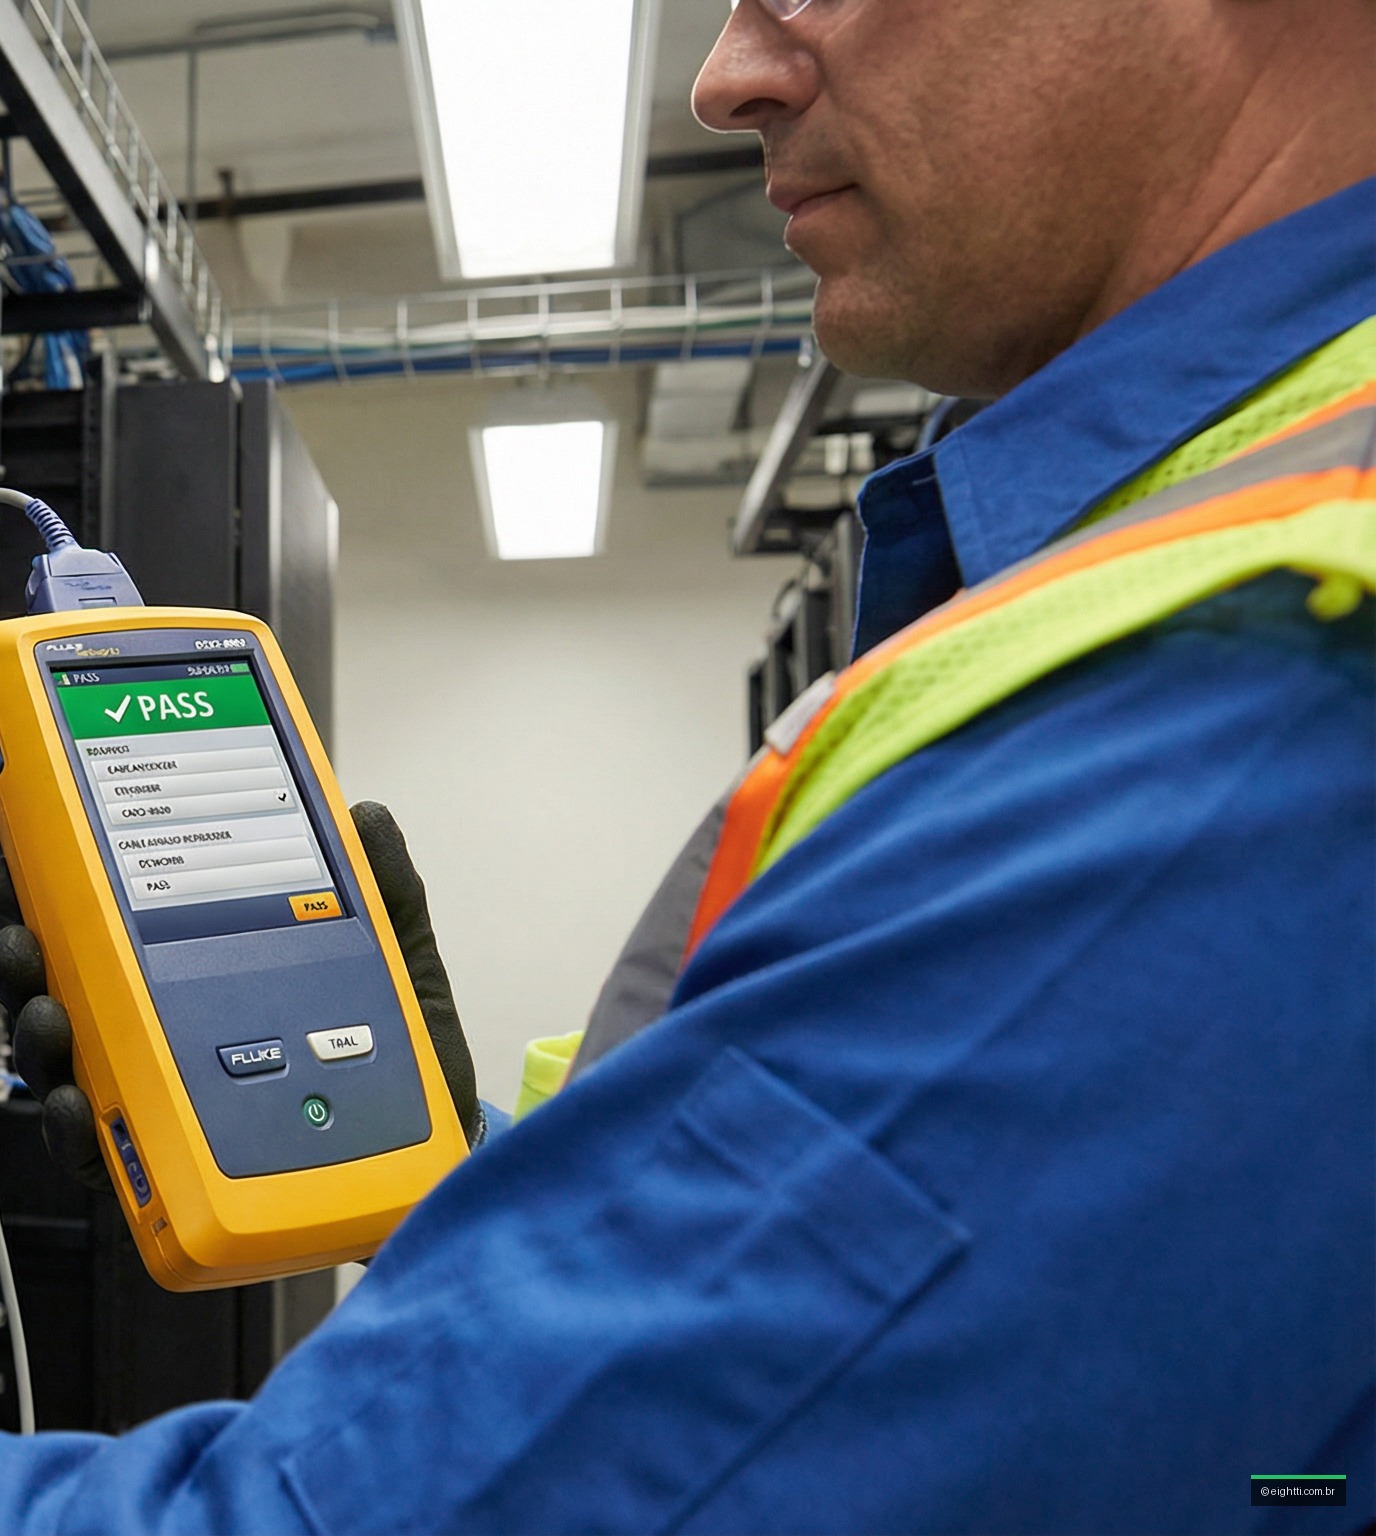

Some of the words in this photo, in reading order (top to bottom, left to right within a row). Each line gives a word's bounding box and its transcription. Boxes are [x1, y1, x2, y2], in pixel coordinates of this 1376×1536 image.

[72, 673, 100, 683] PASS
[137, 691, 214, 721] PASS
[231, 1047, 282, 1066] FLUKE
